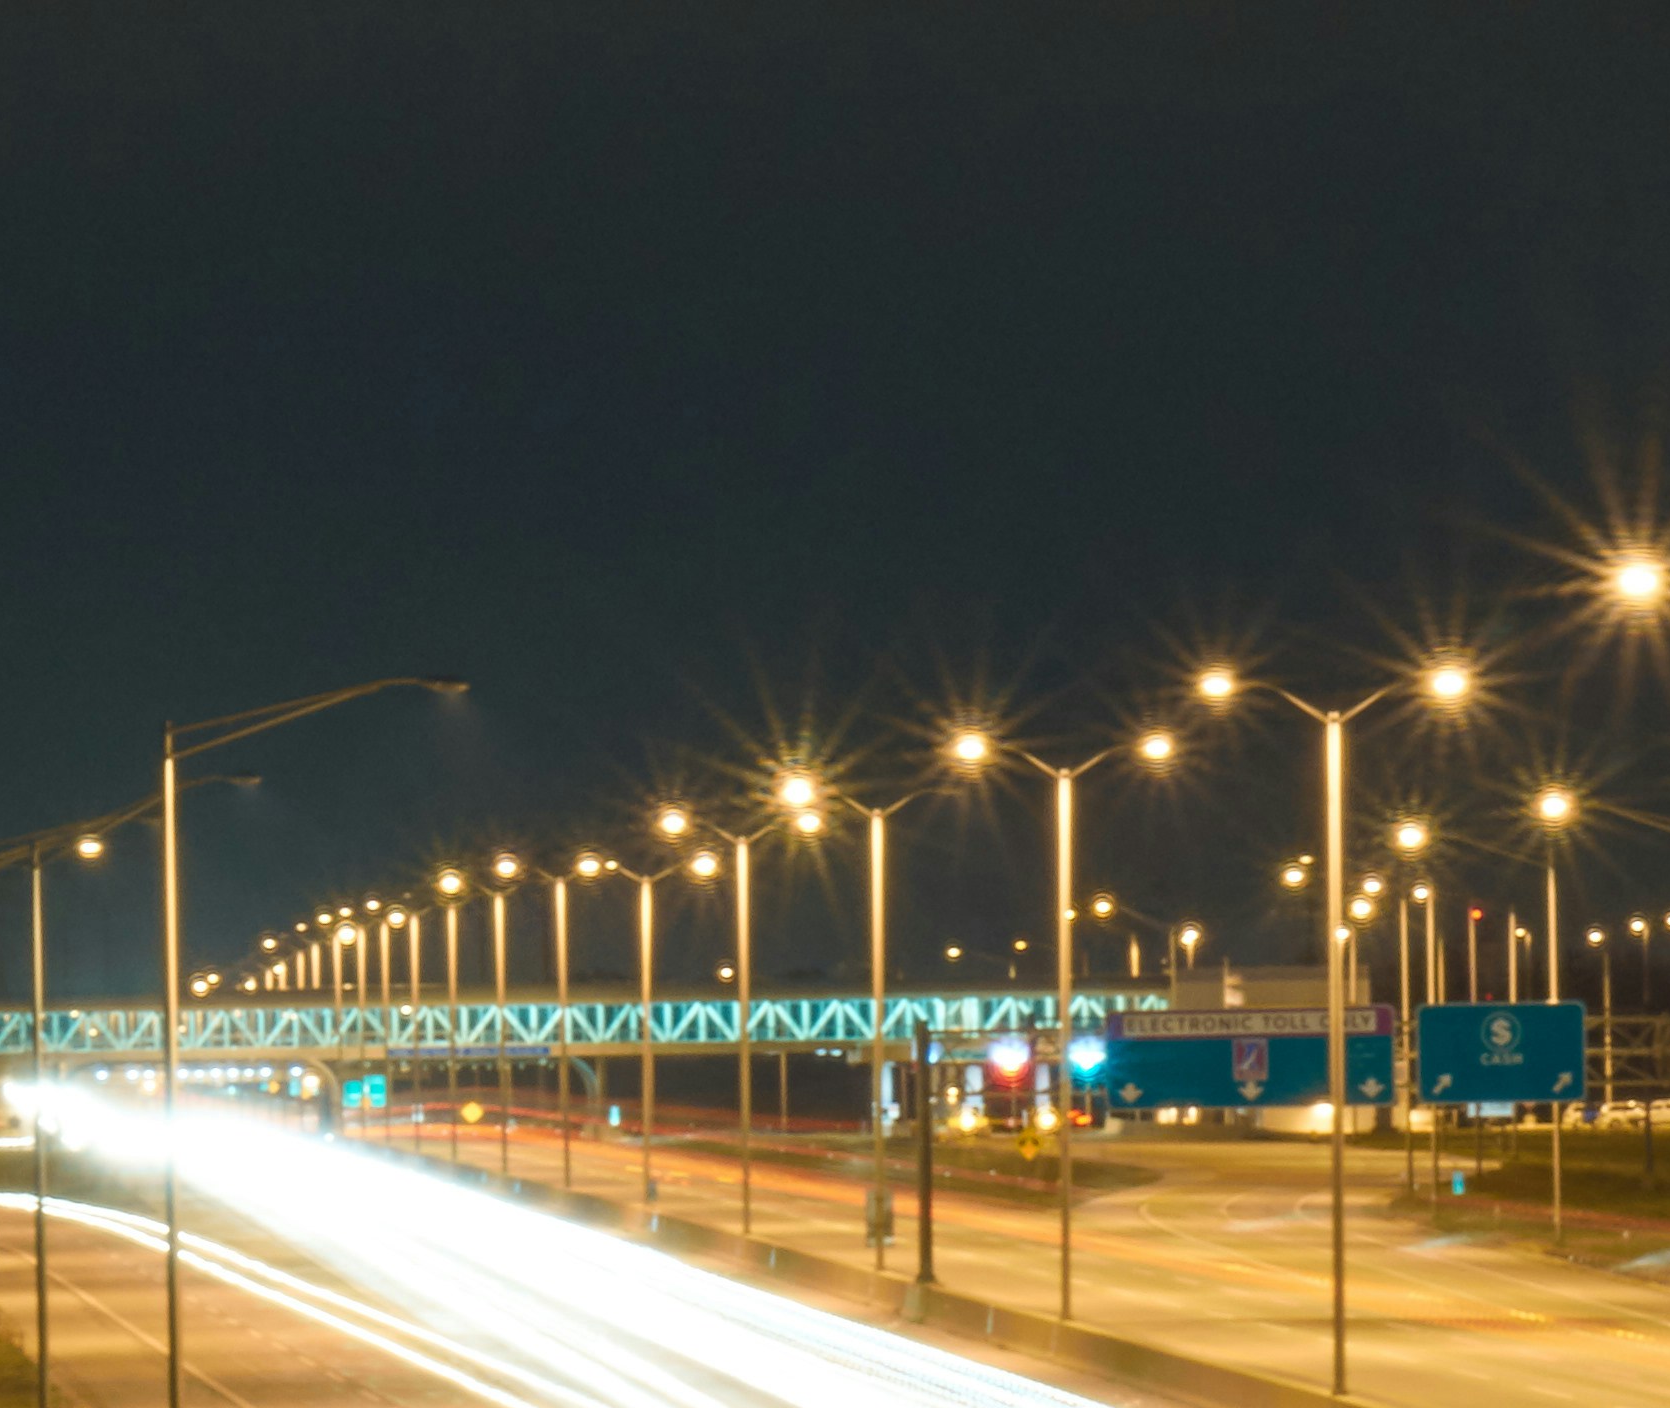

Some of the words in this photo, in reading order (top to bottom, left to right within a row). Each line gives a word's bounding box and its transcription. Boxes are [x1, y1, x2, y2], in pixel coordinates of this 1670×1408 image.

[1126, 1014, 1252, 1033] ELECTRONIC
[1262, 1013, 1310, 1030] TOLL
[1319, 1012, 1371, 1029] OLY
[1479, 1052, 1523, 1066] CASH
